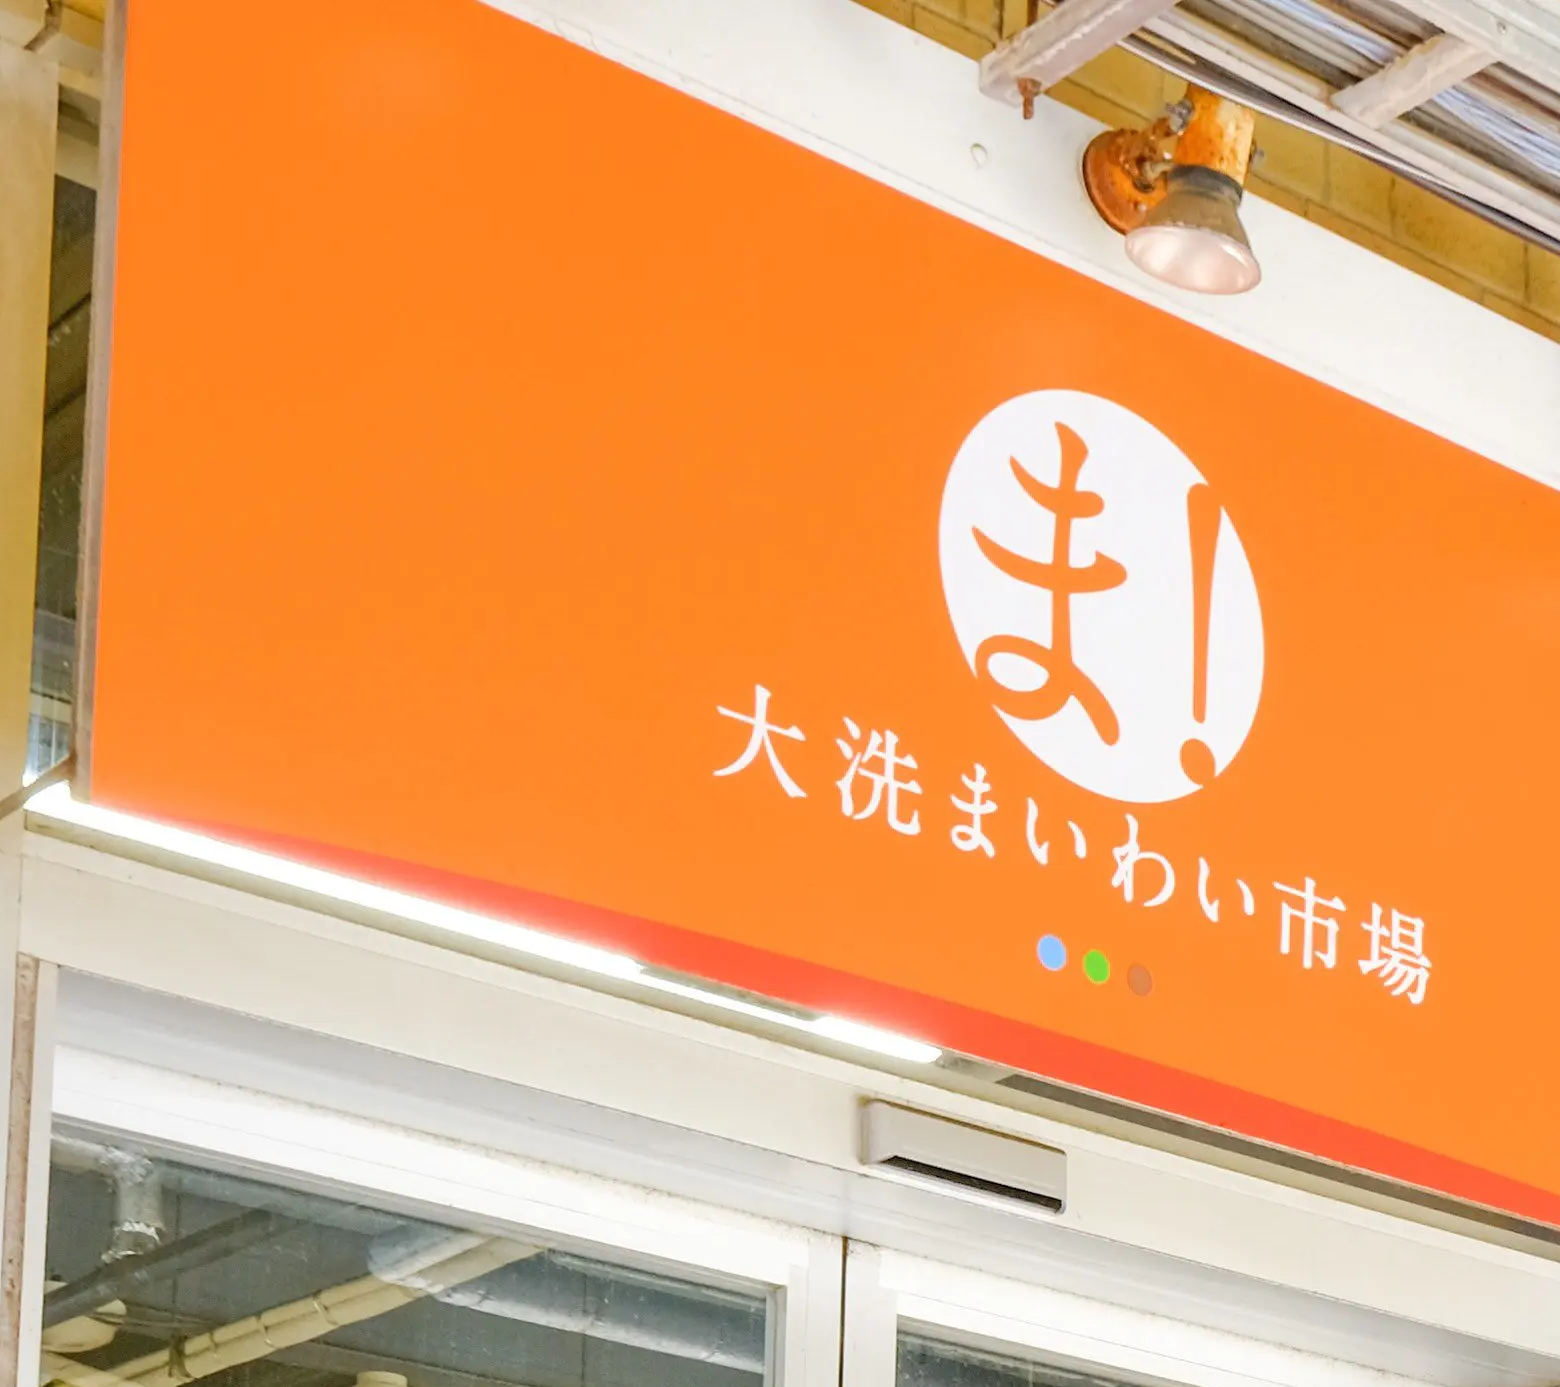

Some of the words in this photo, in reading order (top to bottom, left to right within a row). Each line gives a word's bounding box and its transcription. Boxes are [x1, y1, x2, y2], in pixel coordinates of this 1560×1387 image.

[713, 684, 1433, 1005] 大洗まいわい市場
